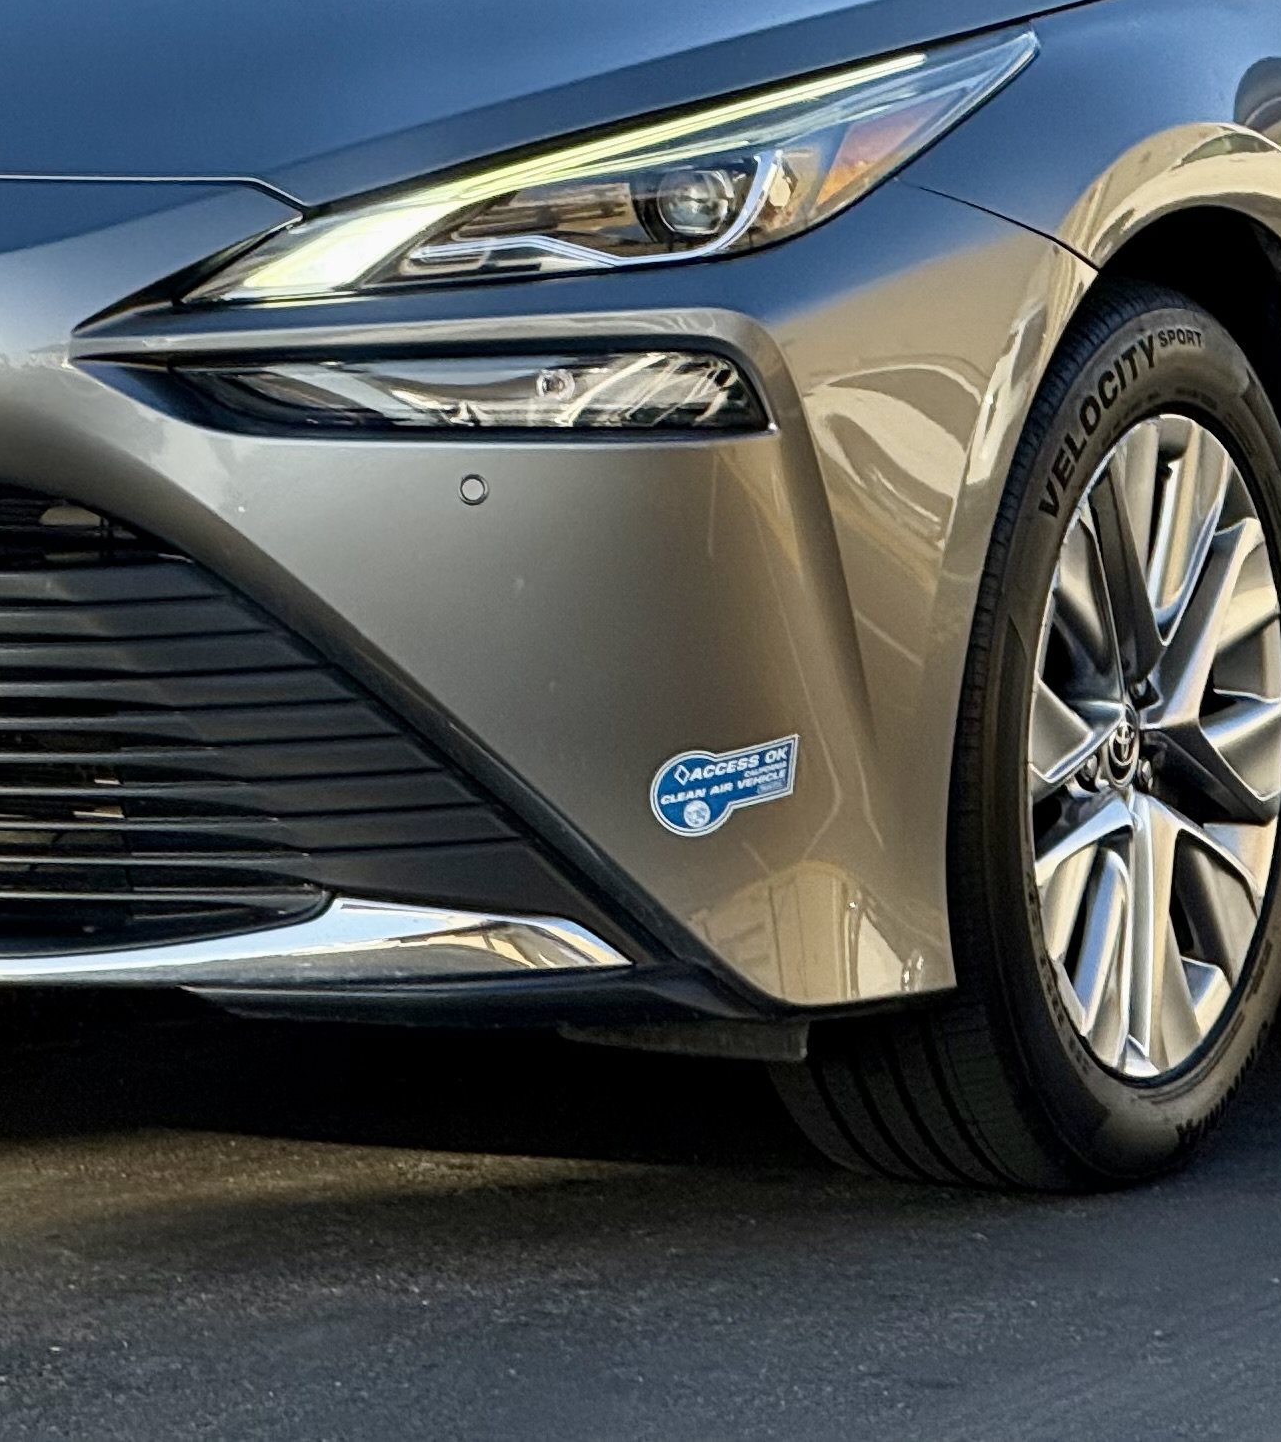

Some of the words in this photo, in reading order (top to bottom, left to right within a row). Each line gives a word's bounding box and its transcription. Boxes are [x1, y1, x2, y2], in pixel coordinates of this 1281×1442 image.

[1038, 334, 1158, 519] VELOCITY
[1158, 327, 1203, 349] SPORT
[689, 755, 760, 782] ACCESS
[764, 746, 789, 762] OK
[660, 788, 707, 806] CLEAN
[709, 782, 733, 796] AIR
[736, 768, 787, 790] VEHICLE
